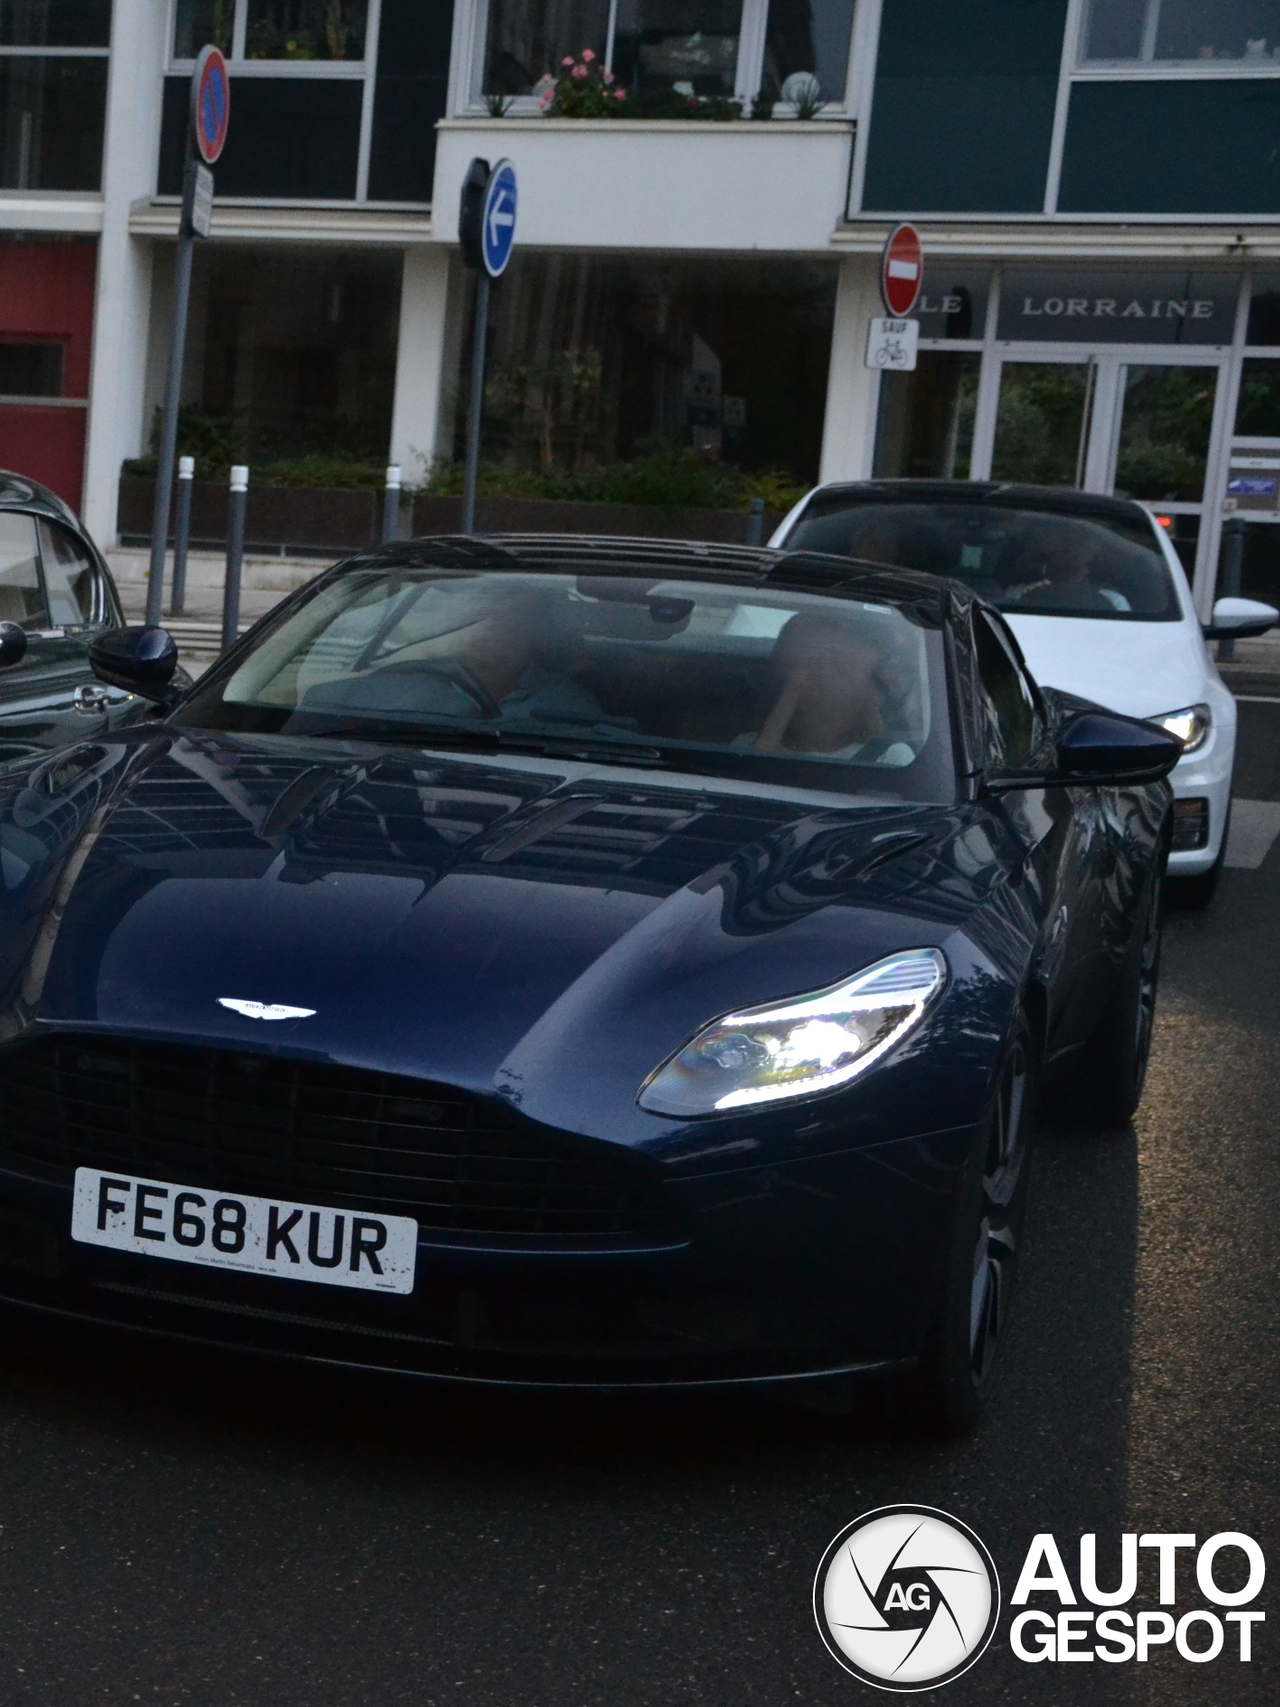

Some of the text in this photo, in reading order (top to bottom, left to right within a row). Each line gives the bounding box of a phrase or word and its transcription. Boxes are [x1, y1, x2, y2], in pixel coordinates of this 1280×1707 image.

[1022, 297, 1215, 319] LORRAINE
[882, 321, 908, 333] SAUF
[96, 1176, 388, 1275] FE68 KUR
